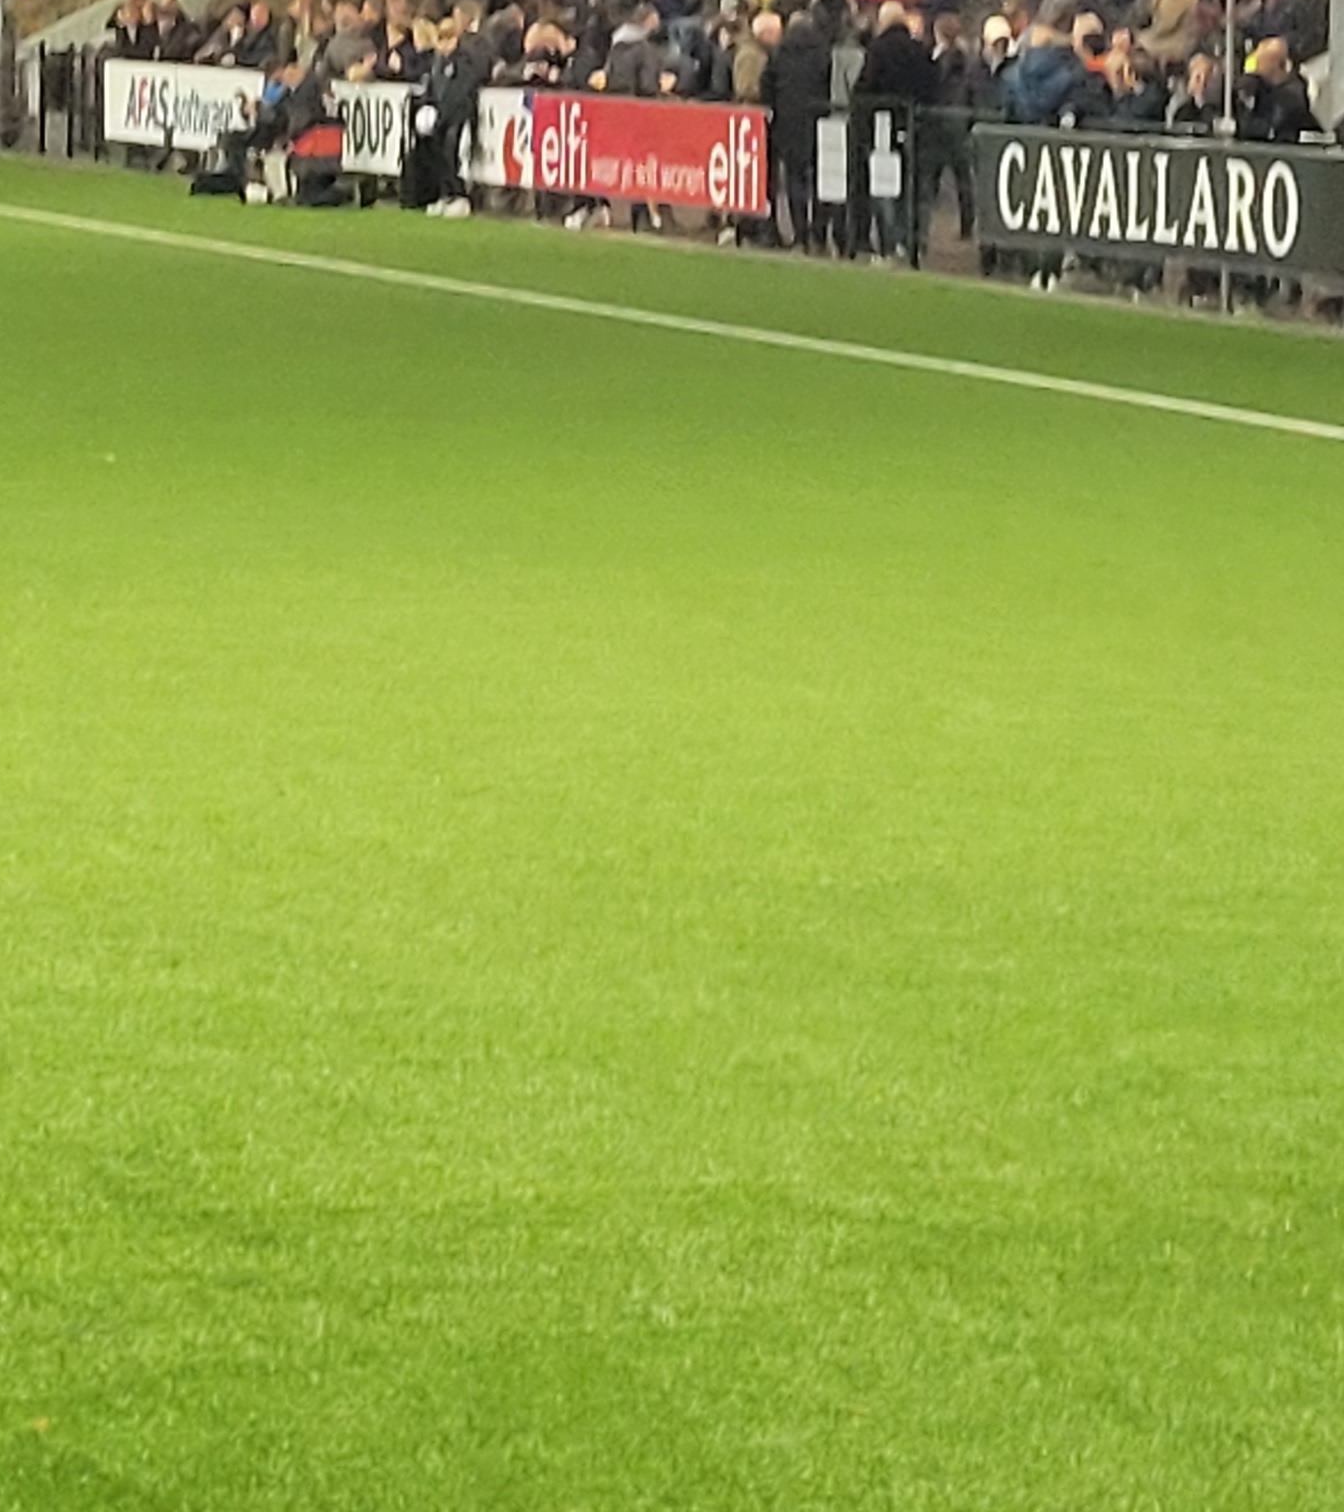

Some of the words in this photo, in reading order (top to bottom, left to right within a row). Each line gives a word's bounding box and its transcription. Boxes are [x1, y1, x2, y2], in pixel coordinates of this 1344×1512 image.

[124, 74, 169, 130] AFAS
[541, 101, 588, 189] elfi
[709, 114, 759, 211] elfi
[998, 140, 1299, 259] CAVALLARO
